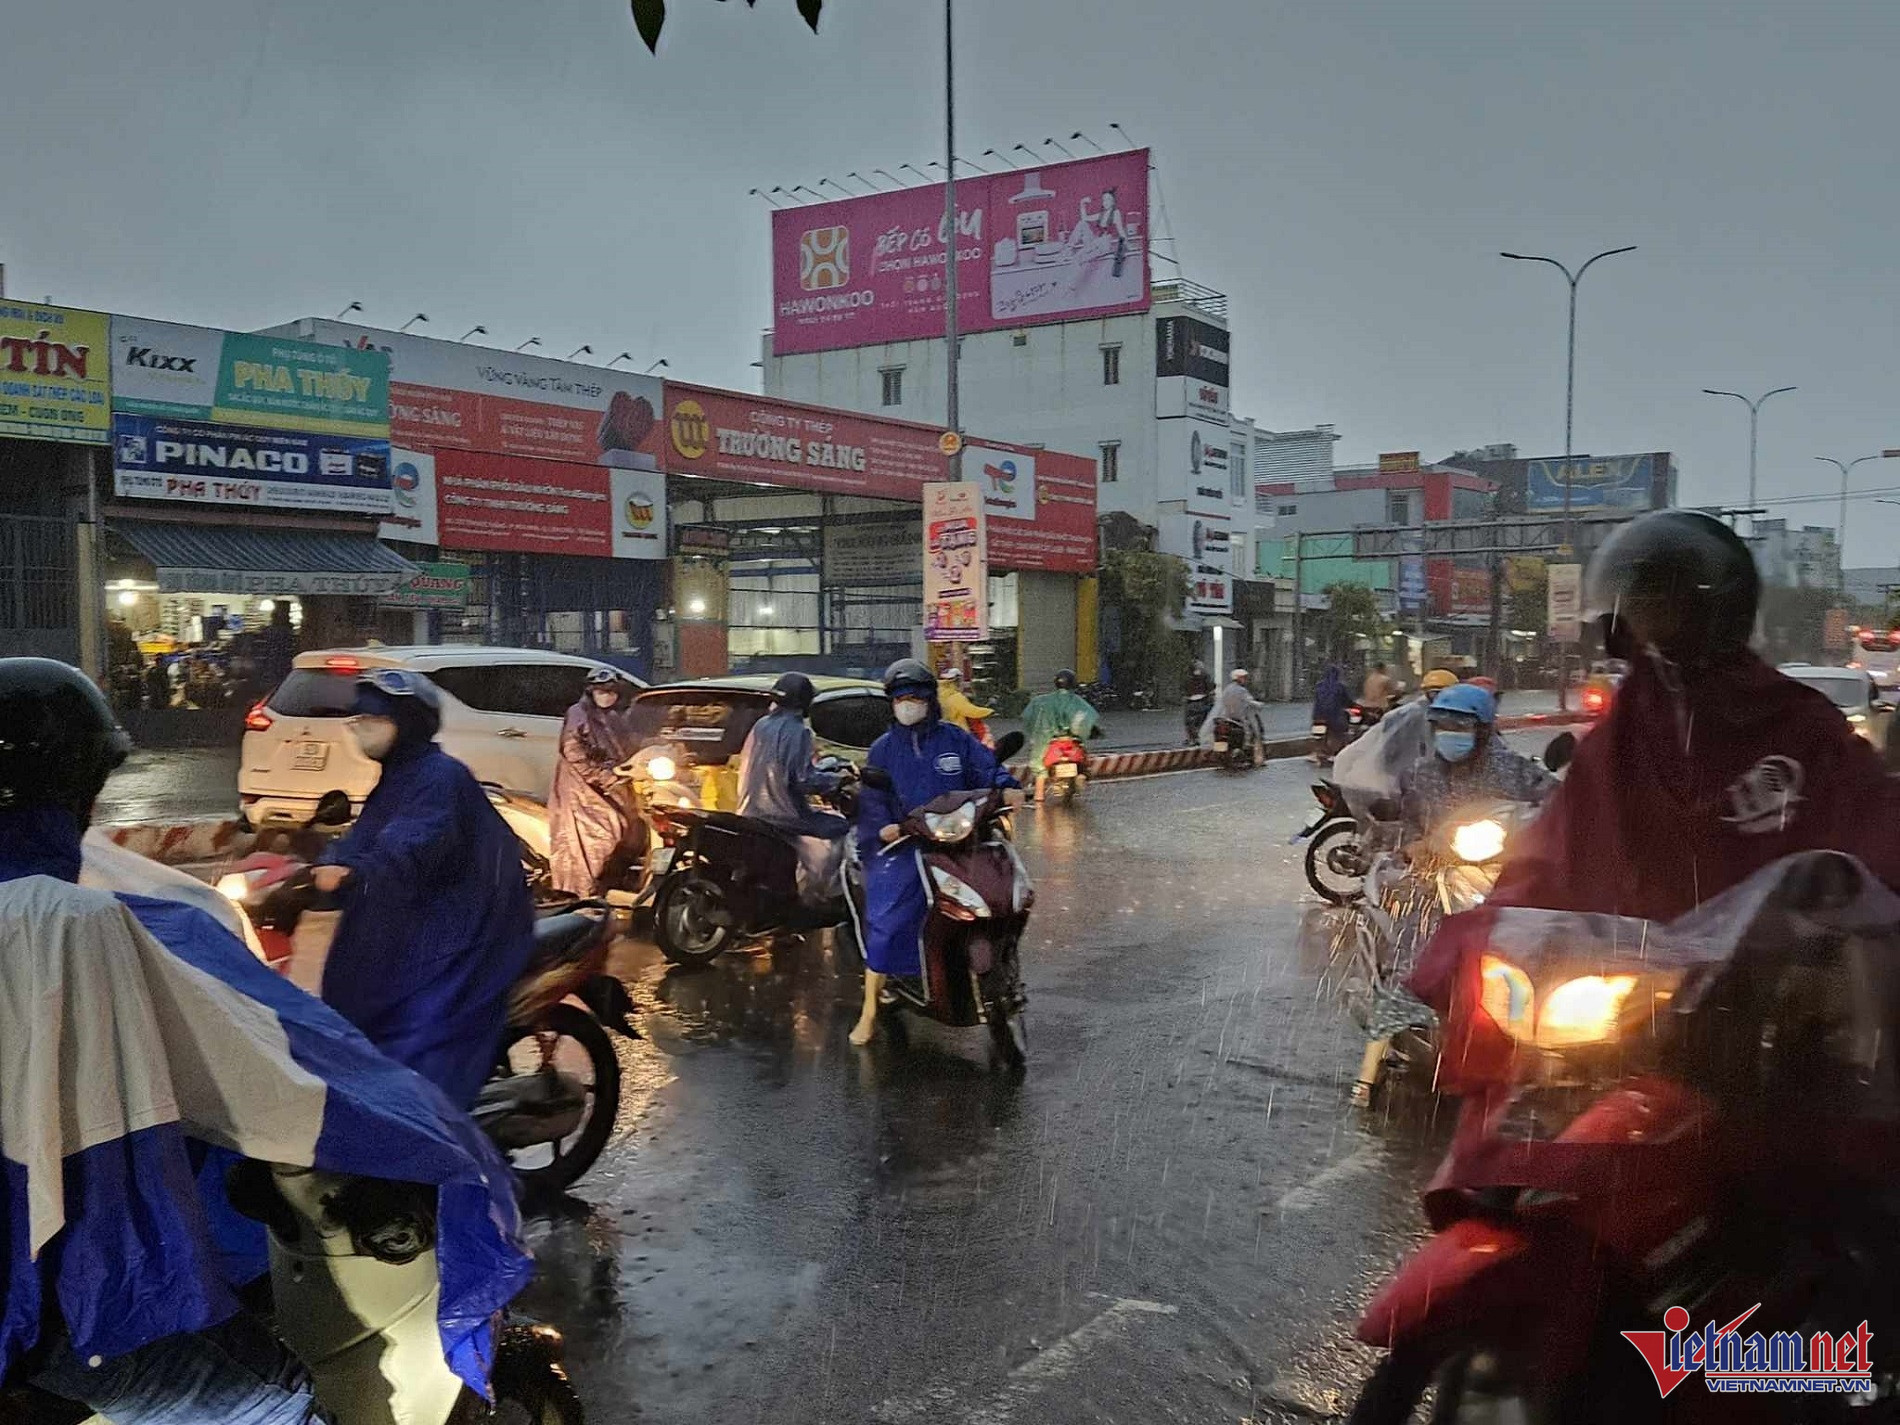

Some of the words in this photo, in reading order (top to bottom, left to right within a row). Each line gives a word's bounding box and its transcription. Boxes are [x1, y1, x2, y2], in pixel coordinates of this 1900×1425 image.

[912, 247, 982, 267] HAWOKOO
[780, 290, 874, 316] HAWONKOO
[1, 329, 90, 379] TÍN
[233, 360, 295, 393] PHA
[155, 440, 309, 474] PINACO
